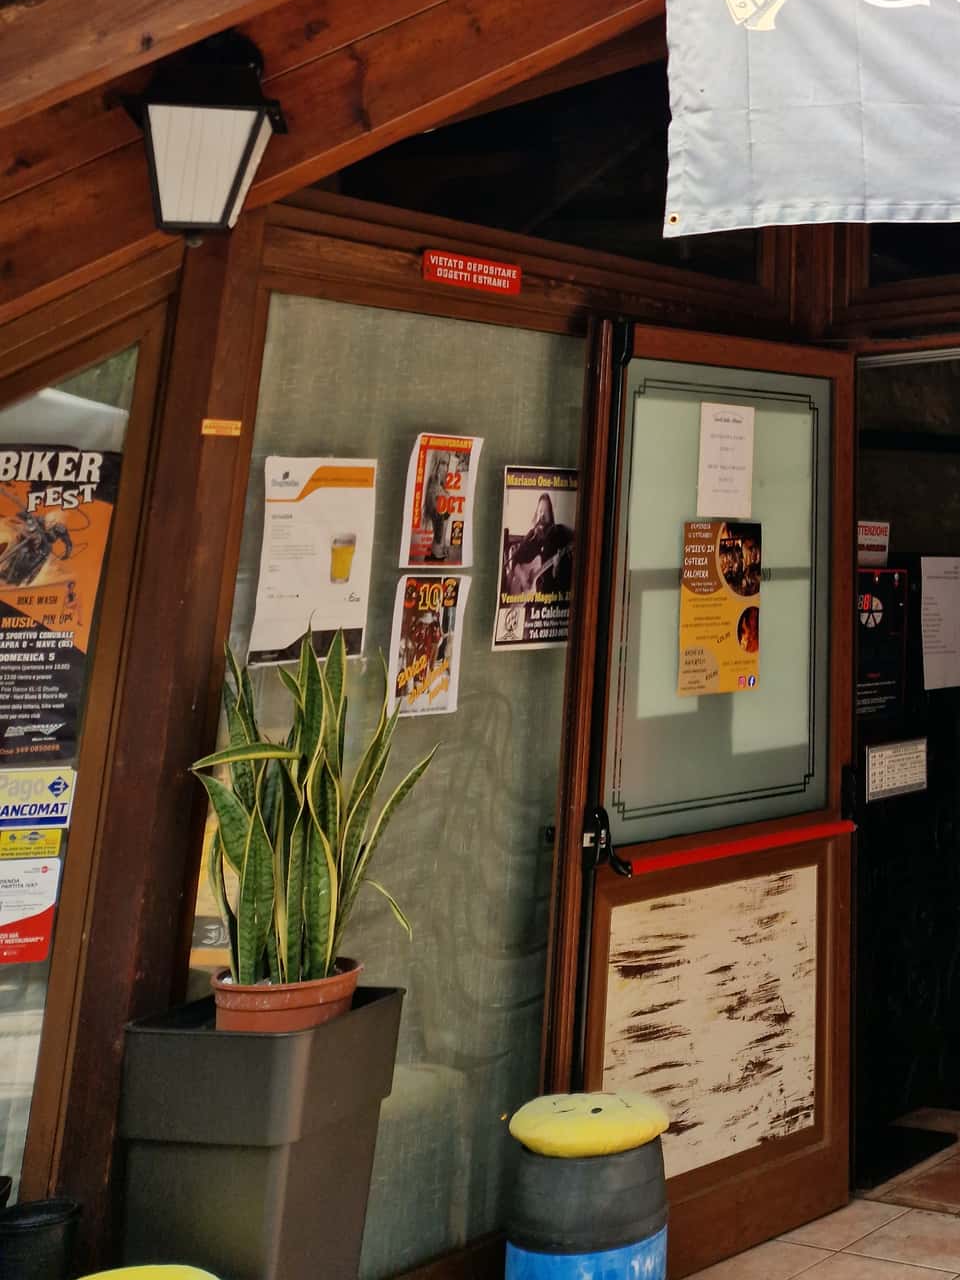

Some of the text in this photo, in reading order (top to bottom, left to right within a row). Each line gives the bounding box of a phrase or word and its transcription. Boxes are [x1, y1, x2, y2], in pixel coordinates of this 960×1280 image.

[430, 255, 517, 279] VIETATO DEPOSITARE
[436, 268, 510, 289] OGGETTI ESTRANEI
[0, 451, 103, 482] BIKER
[444, 472, 463, 491] 22
[507, 474, 537, 487] Mariano
[27, 484, 97, 513] FEST
[436, 495, 467, 515] OCT
[535, 591, 558, 604] Maggio
[530, 607, 540, 619] La
[1, 616, 39, 629] MUSIC
[6, 631, 74, 640] SPORTIVO COMUNALE
[36, 640, 57, 649] NAVE
[0, 652, 56, 662] DOMENICA 5
[0, 802, 67, 816] ANCOMAT
